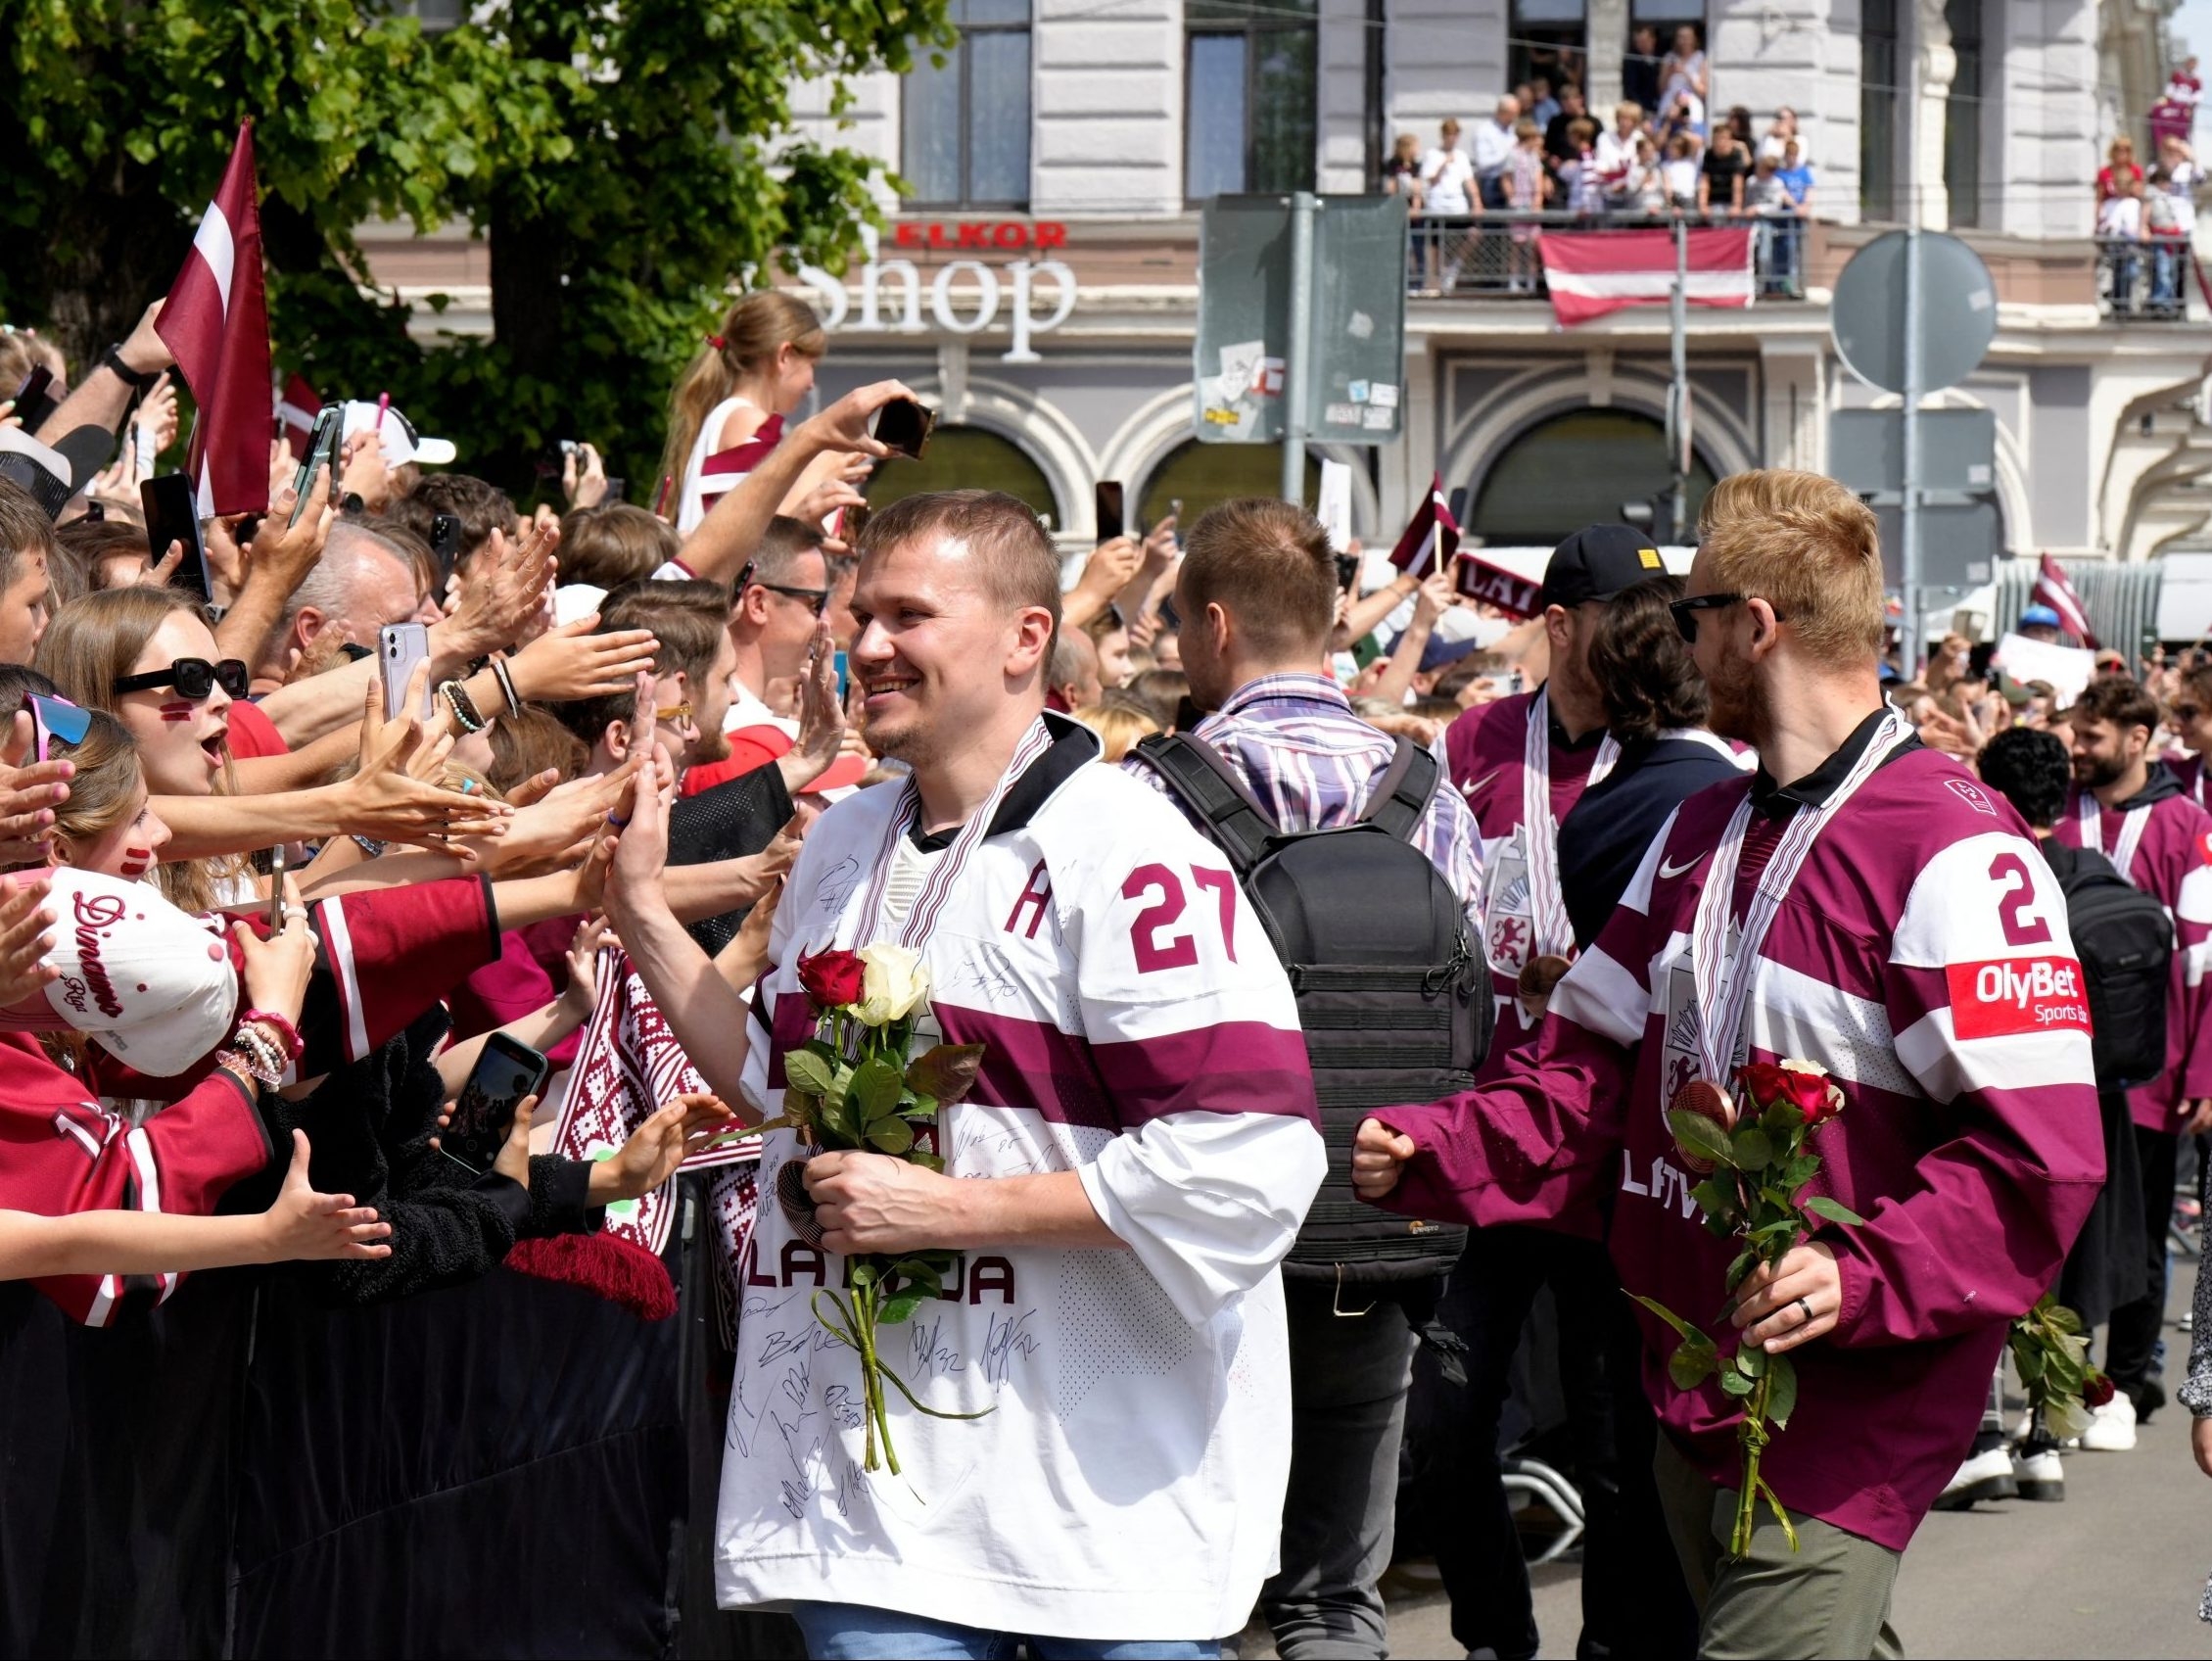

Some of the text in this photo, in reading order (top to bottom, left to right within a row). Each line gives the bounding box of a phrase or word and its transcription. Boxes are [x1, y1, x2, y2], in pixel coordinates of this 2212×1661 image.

[896, 221, 1067, 249] ELKOR
[1004, 858, 1055, 940] A
[1121, 862, 1238, 974] 27
[1988, 852, 2053, 947] 2
[72, 890, 125, 1019] Dinamo
[1976, 962, 2078, 1010] OlyBet
[2035, 1004, 2077, 1026] Sports
